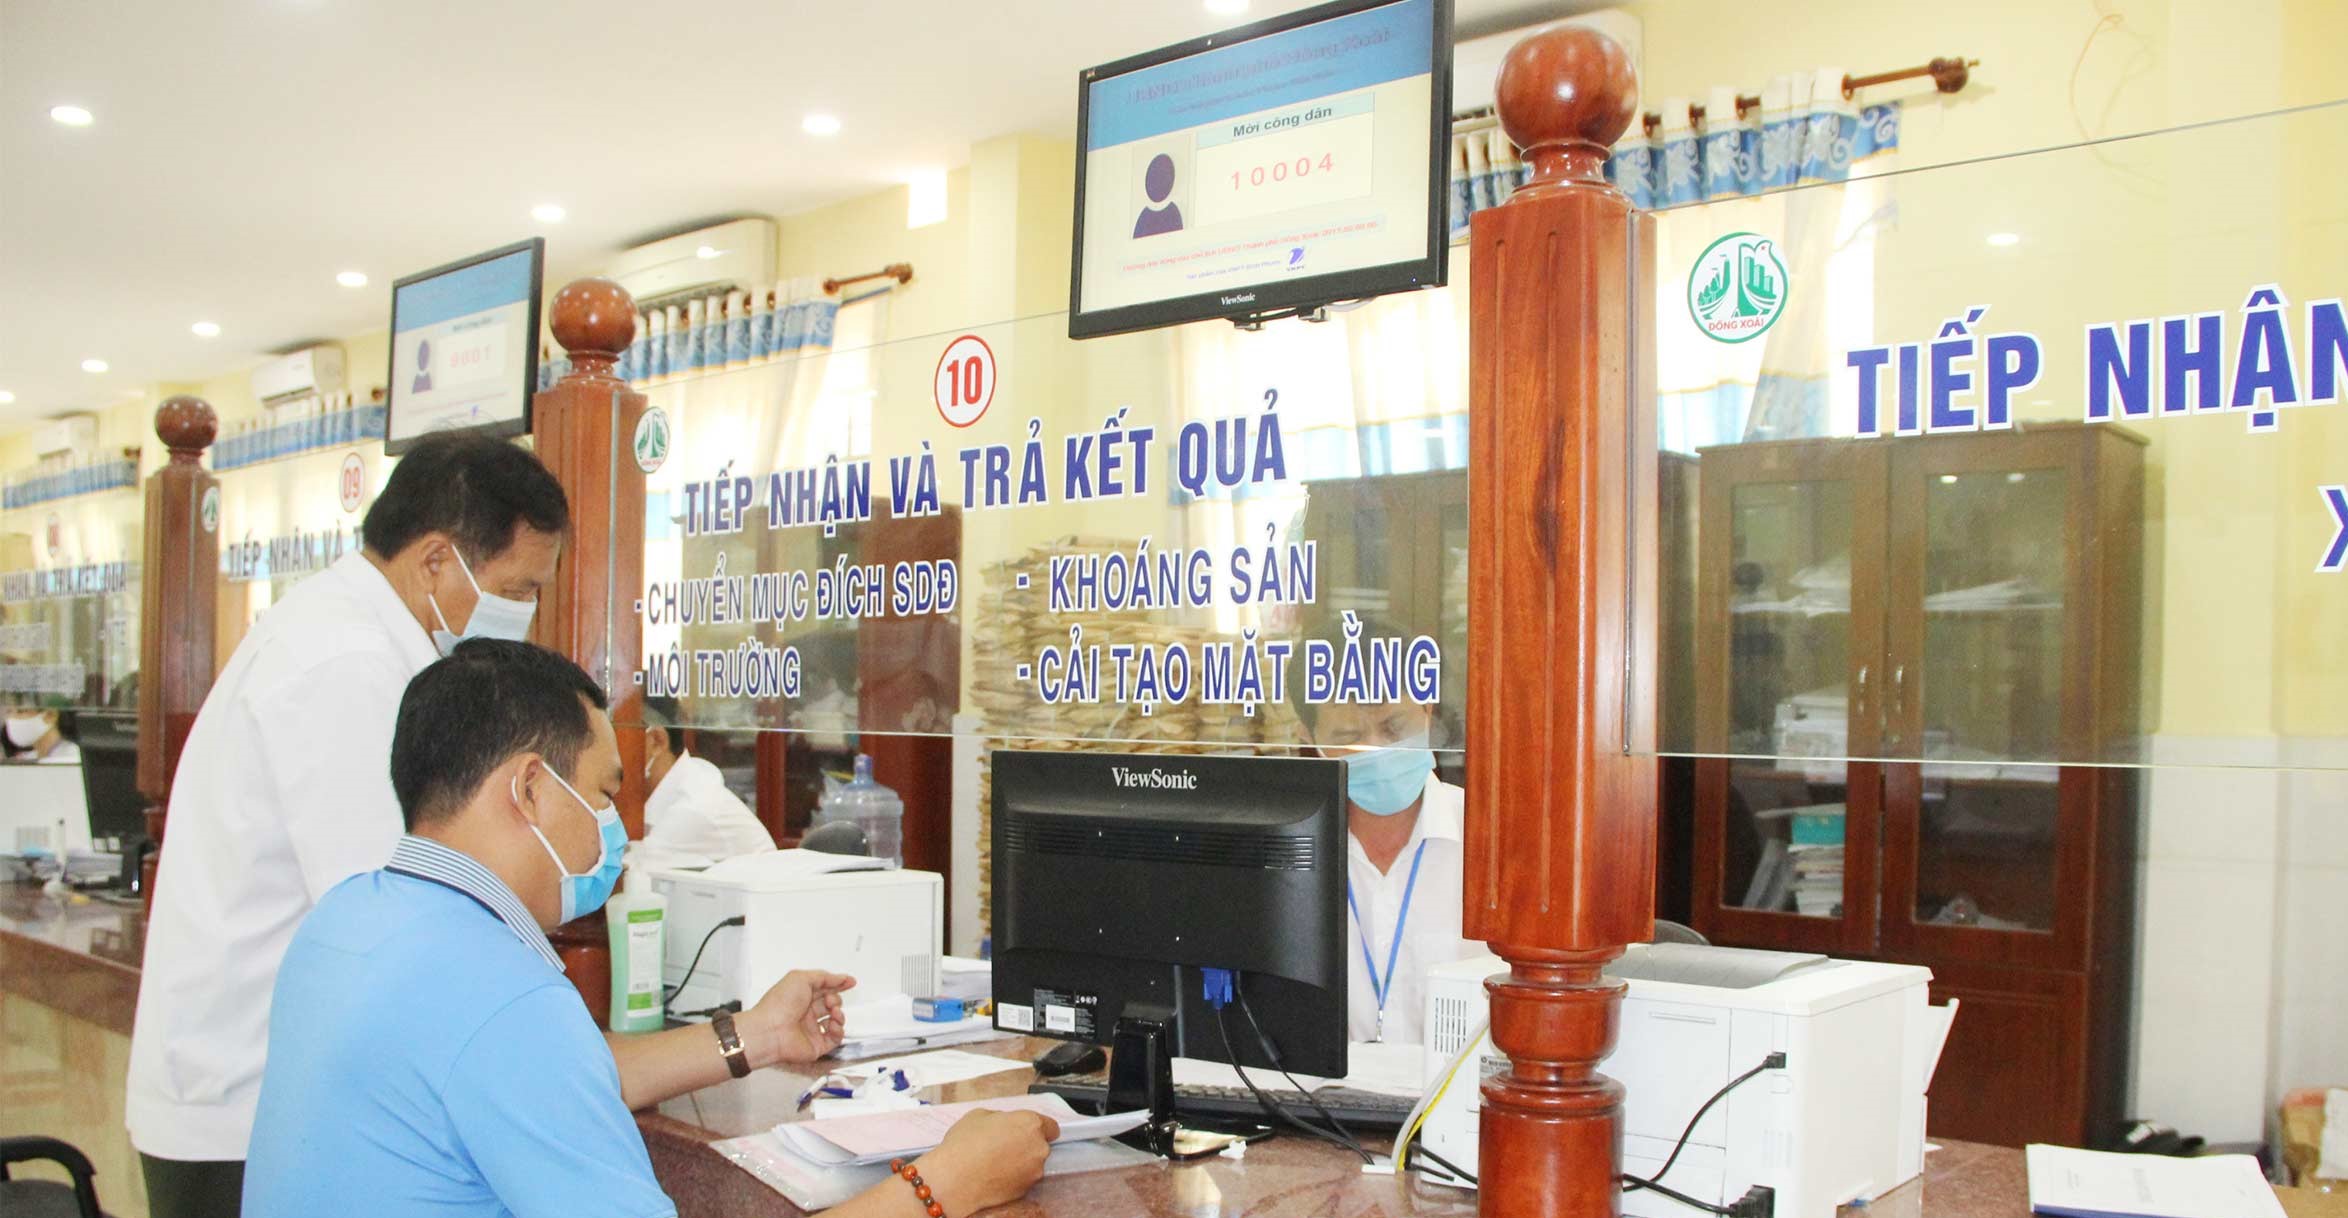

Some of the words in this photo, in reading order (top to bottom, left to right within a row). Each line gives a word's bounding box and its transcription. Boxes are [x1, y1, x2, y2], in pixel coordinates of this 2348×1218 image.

[1233, 123, 1259, 137] Mời
[1264, 115, 1300, 130] công
[1304, 107, 1332, 121] dân
[1220, 292, 1256, 306] ViewSonic
[946, 354, 984, 407] 10
[1846, 303, 2044, 439] TIẾP
[343, 466, 361, 499] 09
[684, 459, 755, 537] TIẾP
[768, 453, 873, 537] NHẬN
[889, 441, 941, 519] VÀ
[959, 417, 1048, 512] TRẢ
[1064, 406, 1155, 502] KẾT
[1178, 388, 1288, 497] QUẢ
[647, 552, 744, 625] CHUYỂN
[751, 569, 809, 631] MỤC
[816, 553, 885, 619] ĐÍCH
[893, 559, 958, 616] SDĐ
[1049, 535, 1214, 613] KHOÁNG
[1230, 522, 1318, 606] SẢN
[647, 641, 690, 697] MÔI
[696, 635, 802, 697] TRƯỜNG
[1038, 623, 1100, 704] CẢI
[1110, 640, 1191, 716] TẠO
[1202, 627, 1293, 716] MẶT
[1305, 609, 1442, 705] BẰNG
[1111, 767, 1198, 789] ViewSonic
